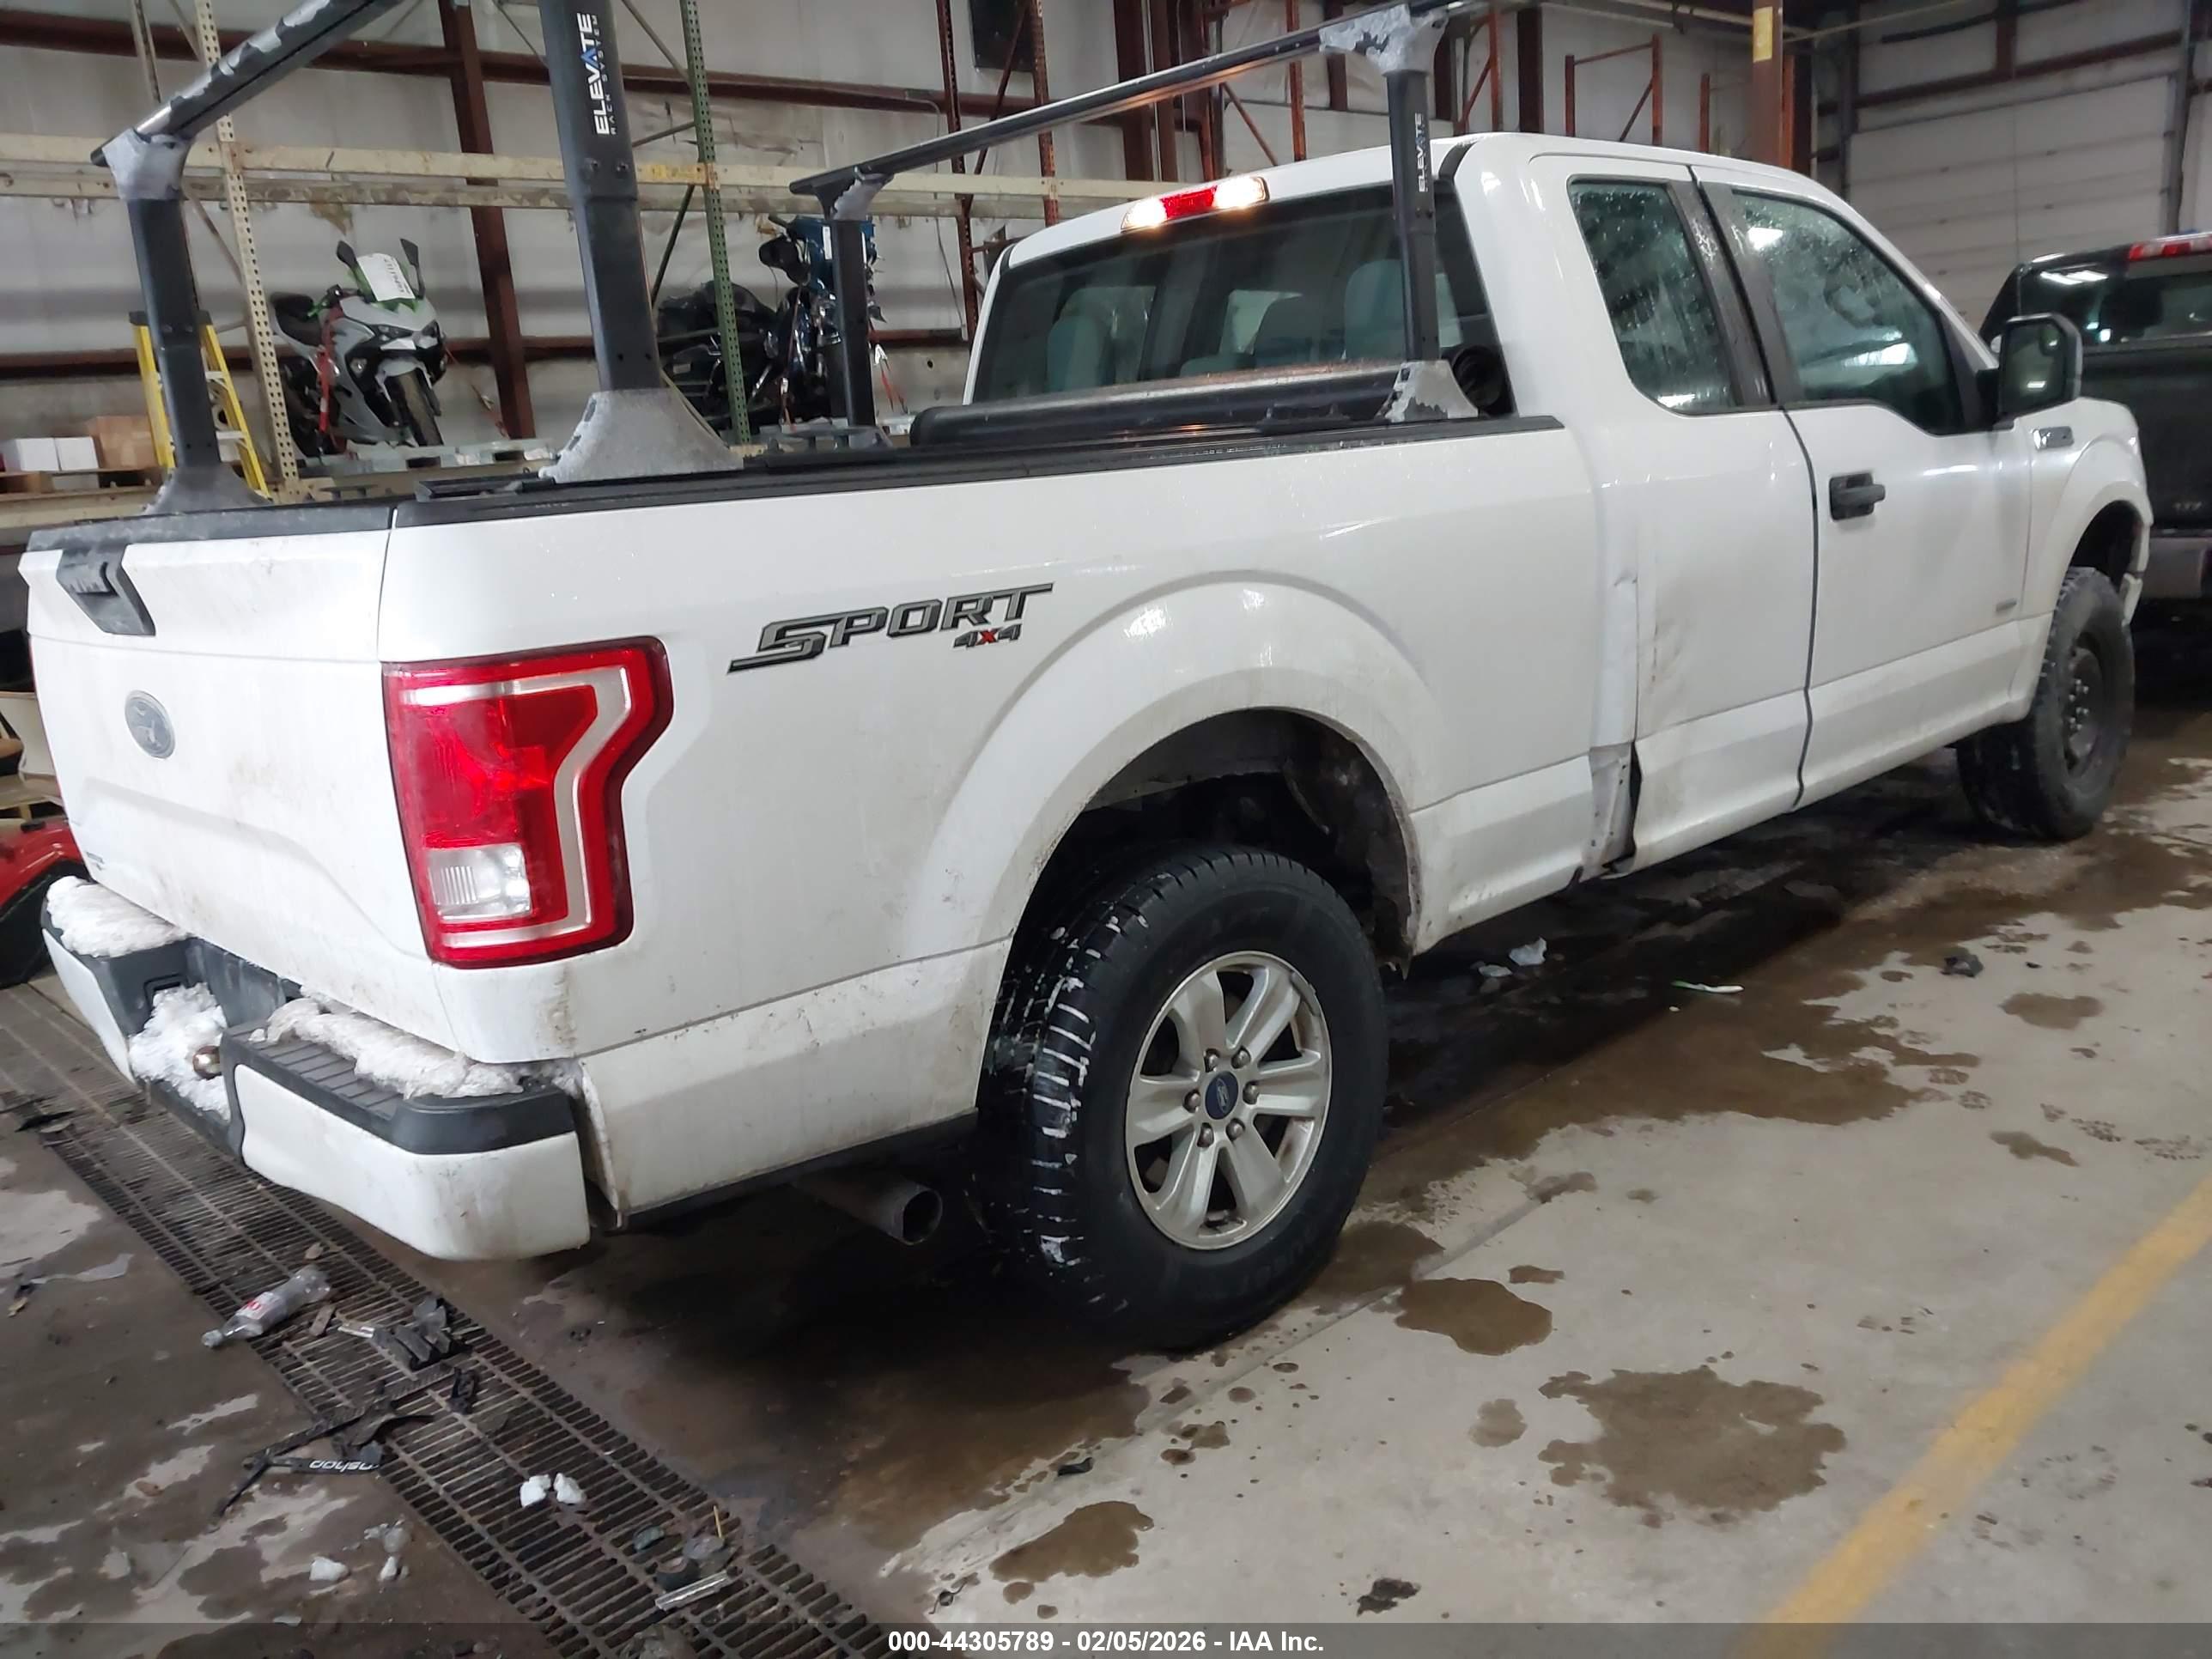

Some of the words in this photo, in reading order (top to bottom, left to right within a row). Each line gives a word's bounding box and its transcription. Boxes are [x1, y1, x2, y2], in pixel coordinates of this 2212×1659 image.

[576, 12, 610, 135] ELEVATE
[591, 15, 608, 82] SYSTEM
[605, 94, 617, 135] RACK
[1414, 112, 1425, 192] ELEVATE
[727, 582, 1054, 674] SPORT
